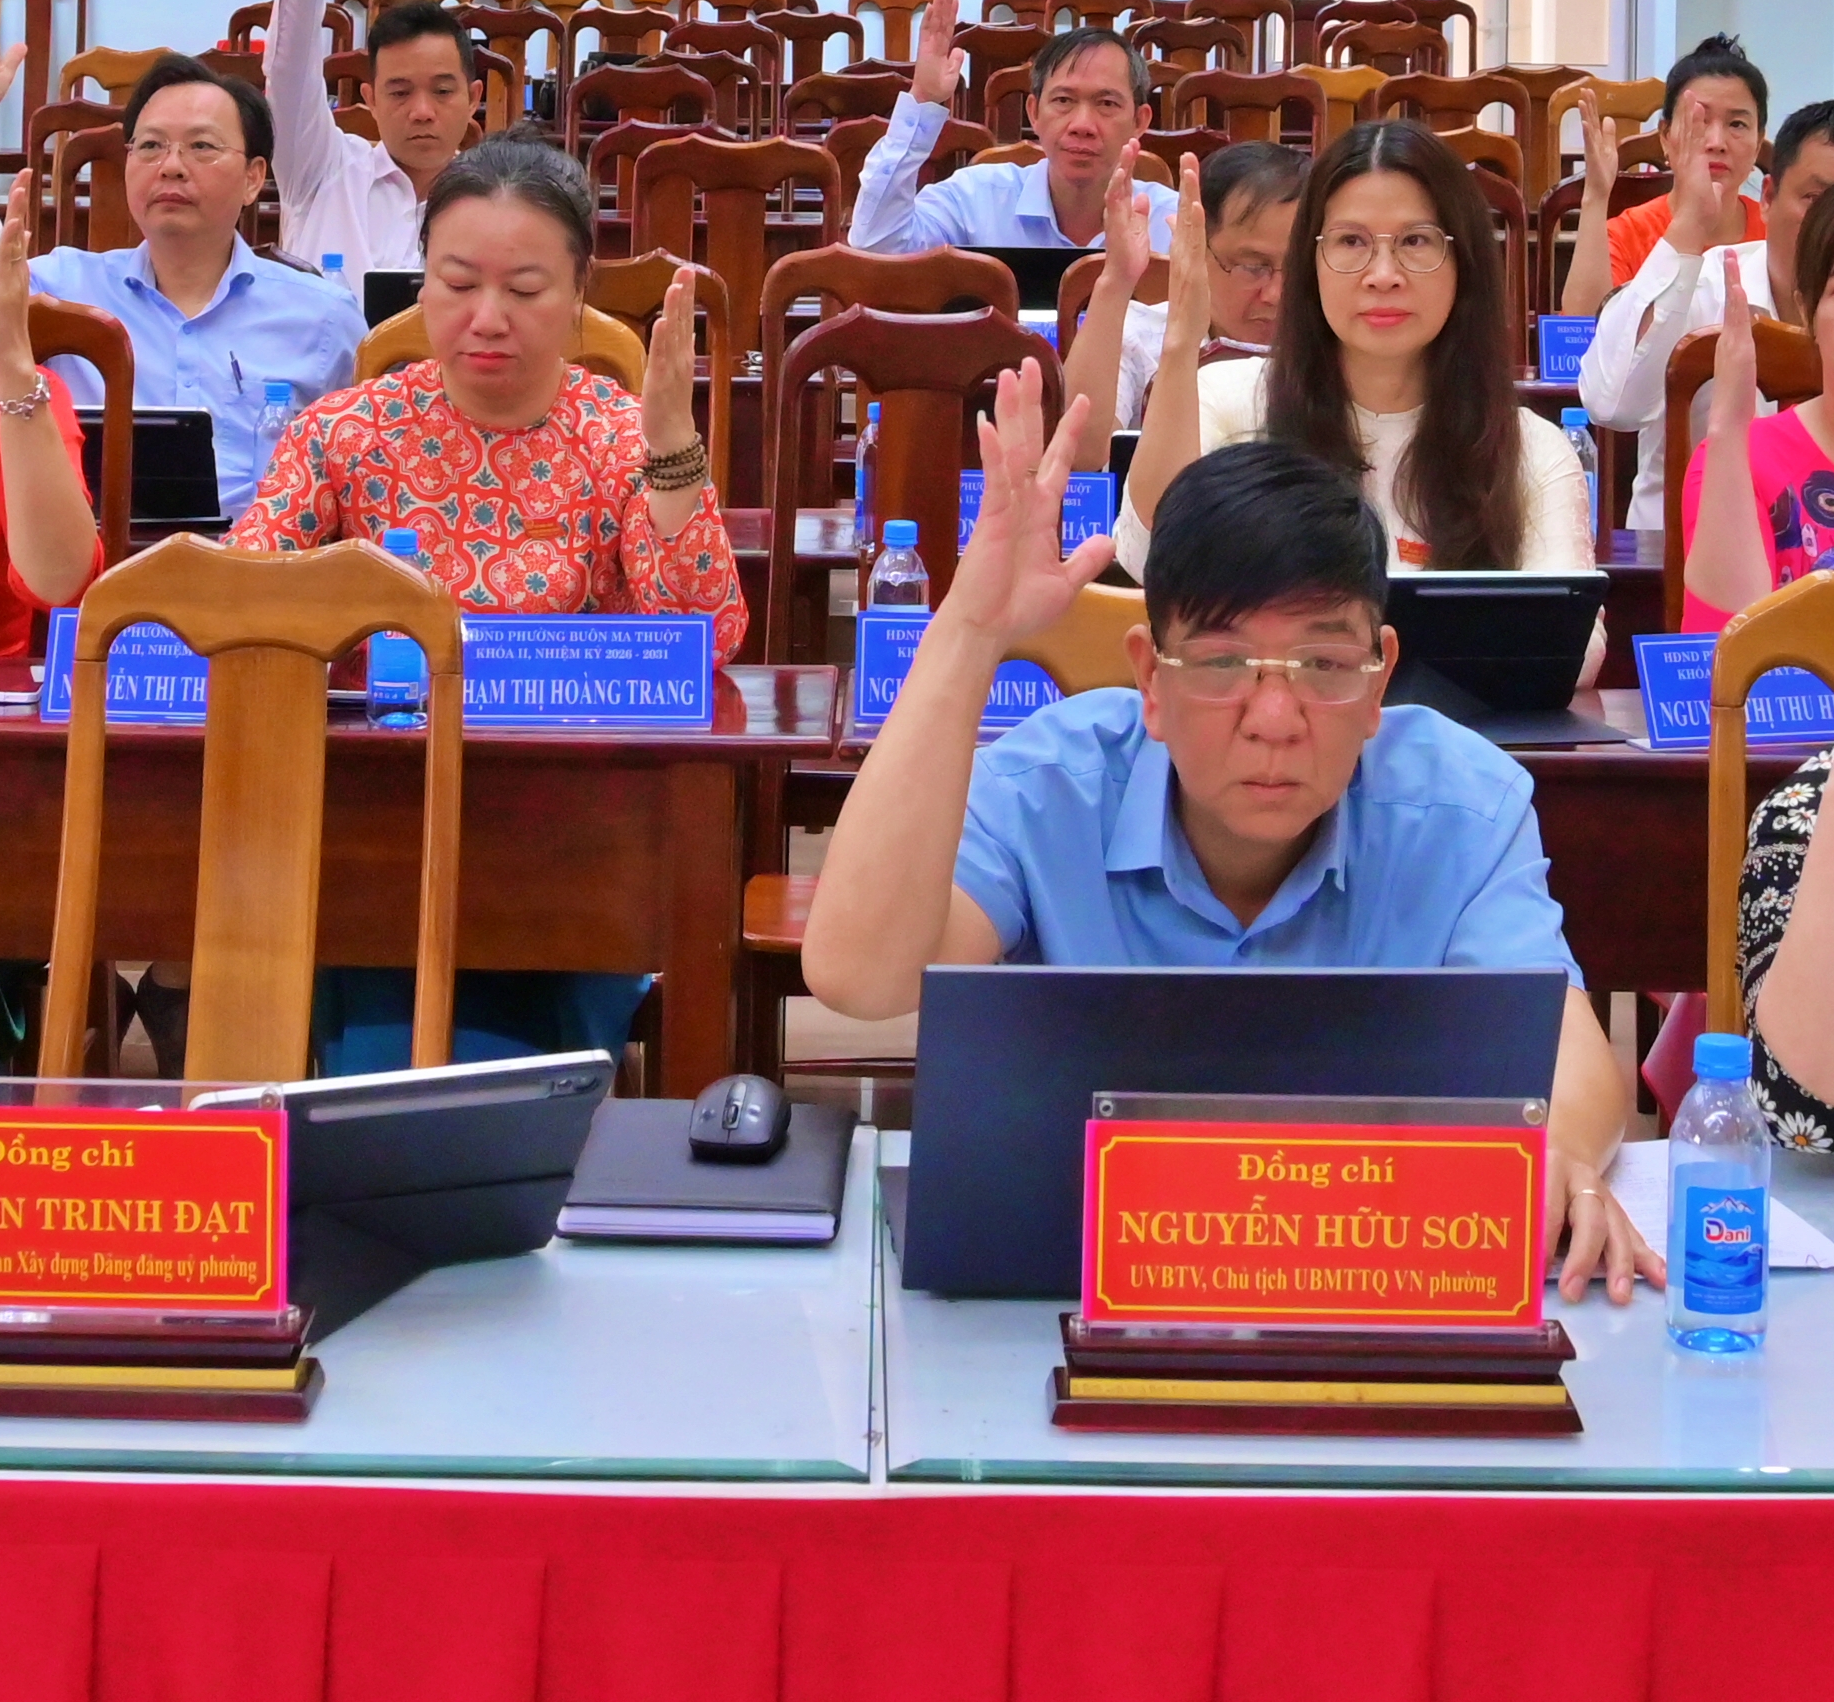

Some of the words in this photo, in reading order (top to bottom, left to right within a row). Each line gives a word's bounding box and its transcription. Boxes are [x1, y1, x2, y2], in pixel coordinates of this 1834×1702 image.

[569, 628, 608, 642] BUÔN
[611, 631, 631, 642] MA
[634, 628, 683, 646] THUỘT
[475, 644, 514, 659] KHÓA
[517, 648, 531, 660] II,
[535, 644, 580, 661] NHIỆM
[605, 648, 633, 659] 2026
[642, 648, 669, 659] 2031
[1663, 651, 1700, 663] HĐND
[143, 675, 177, 709] THỊ
[180, 676, 207, 703] TH
[463, 679, 506, 711] HẠM
[510, 679, 545, 711] THỊ
[550, 671, 621, 705] HOÀNG
[626, 679, 695, 706] TRANG
[987, 681, 1037, 706] MINH
[1775, 695, 1814, 722] THU
[81, 1140, 135, 1167] chí
[1238, 1149, 1332, 1188] Đồng
[1341, 1156, 1395, 1184] chí
[35, 1198, 163, 1234] TRINH
[173, 1200, 254, 1243] ĐẠT
[1117, 1194, 1303, 1247] NGUYỄN
[1314, 1206, 1410, 1249] HỮU
[1421, 1212, 1512, 1250] SƠN
[1703, 1217, 1752, 1244] Dani
[17, 1250, 46, 1280] Xây
[50, 1252, 89, 1281] dựng
[93, 1252, 133, 1282] Đảng
[136, 1253, 173, 1283] đảng
[200, 1254, 257, 1284] phường
[1129, 1265, 1207, 1292] UVBTV,
[1211, 1265, 1250, 1290] Chủ
[1254, 1266, 1287, 1296] tịch
[1293, 1267, 1388, 1296] UBMTTQ
[1394, 1270, 1424, 1293] VN
[1429, 1270, 1497, 1299] phường
